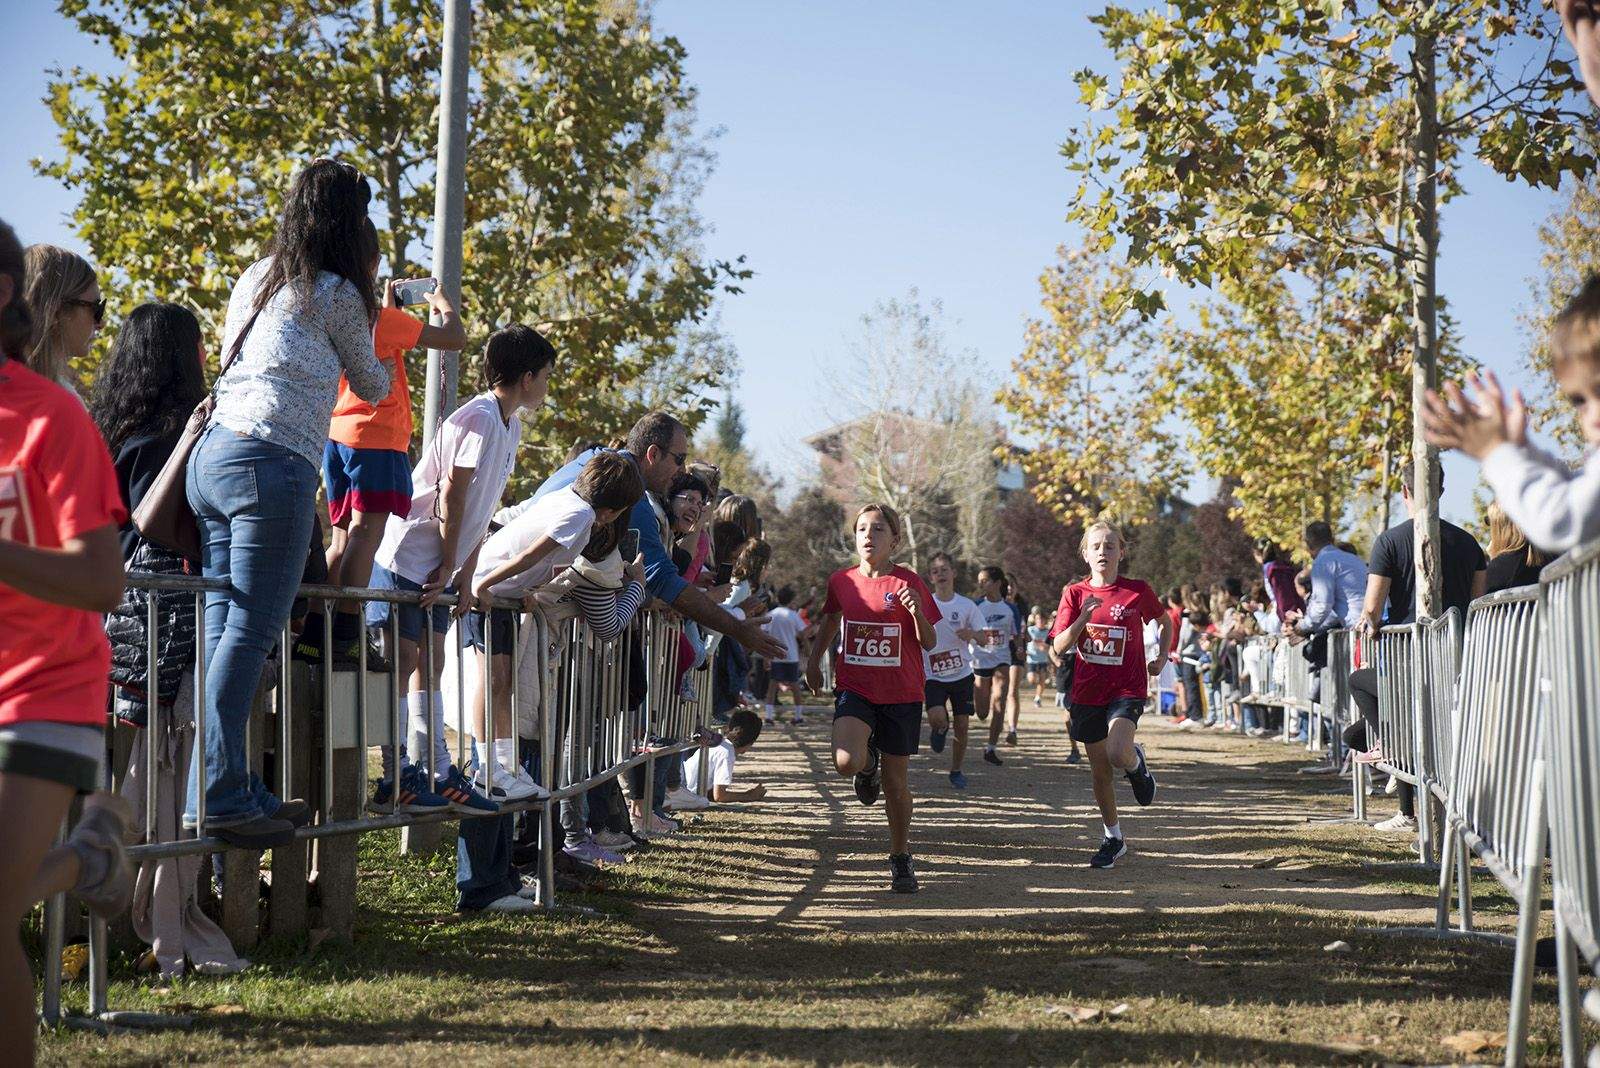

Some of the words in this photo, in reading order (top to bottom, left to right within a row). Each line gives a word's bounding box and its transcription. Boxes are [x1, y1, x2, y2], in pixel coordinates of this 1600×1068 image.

[854, 638, 891, 656] 766
[1083, 638, 1115, 656] 404
[932, 657, 961, 673] 4238
